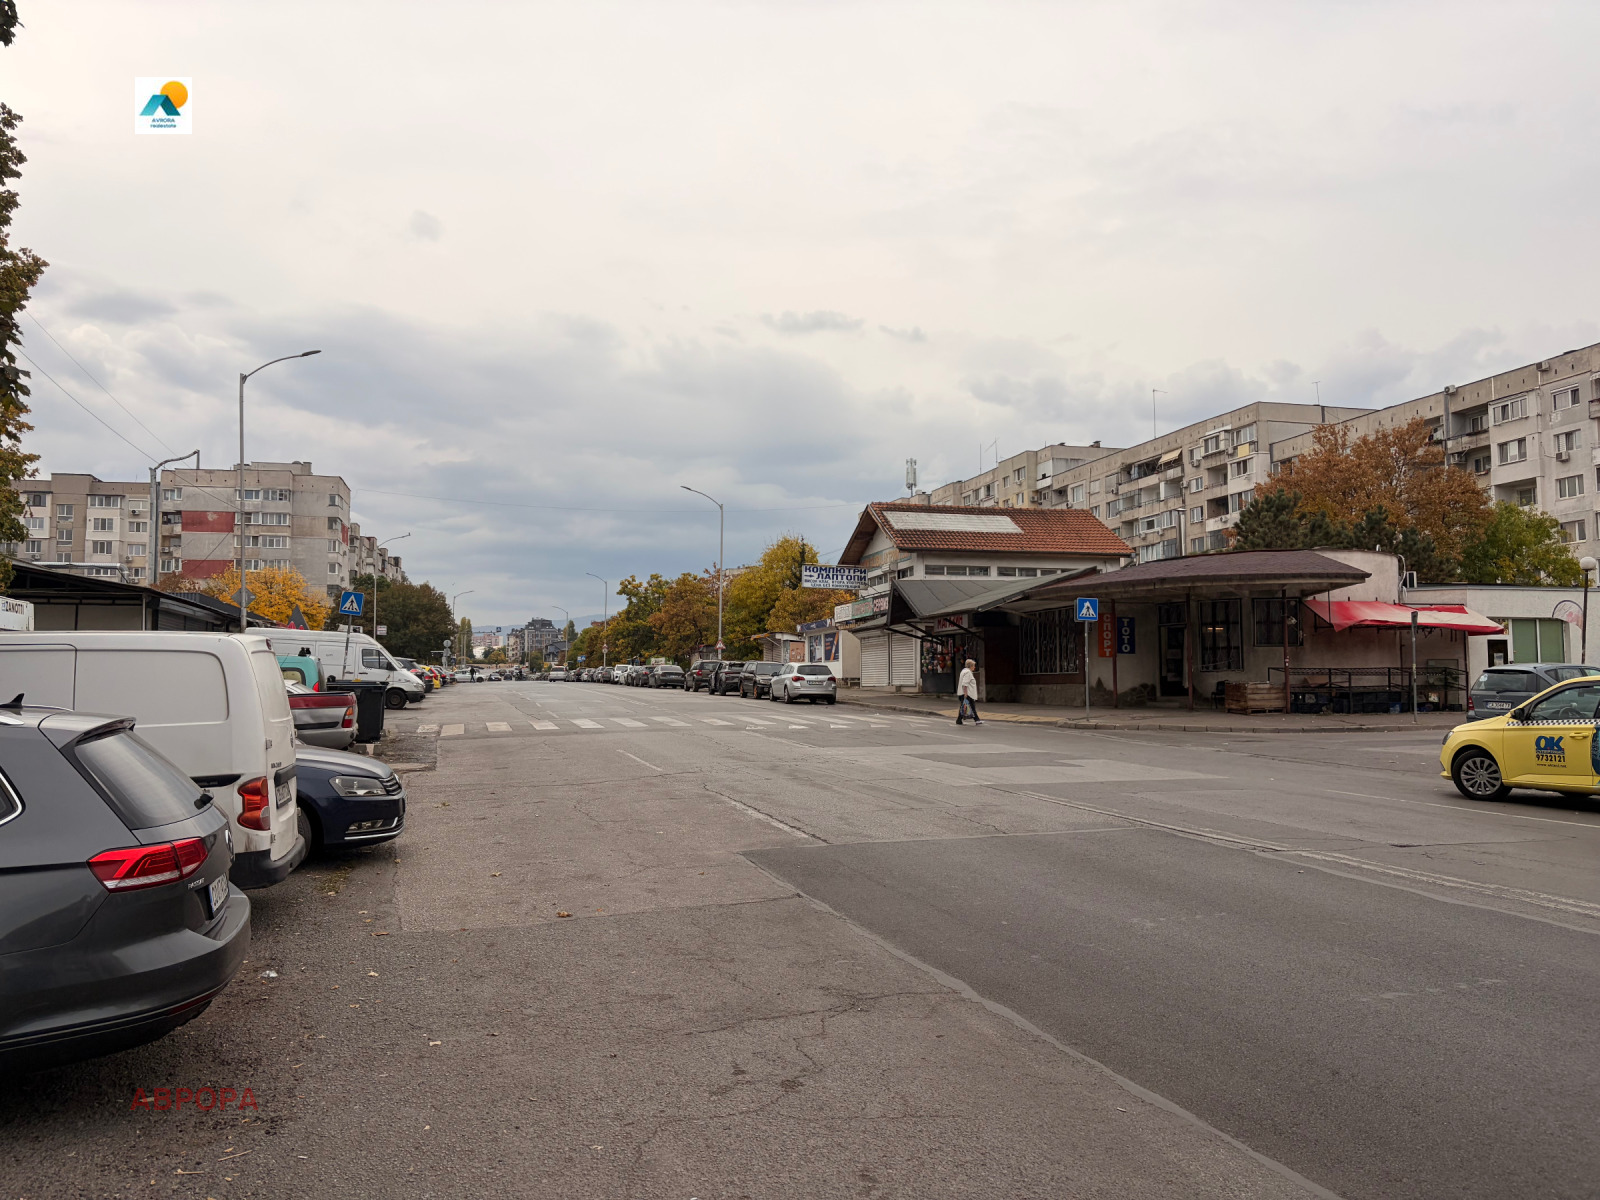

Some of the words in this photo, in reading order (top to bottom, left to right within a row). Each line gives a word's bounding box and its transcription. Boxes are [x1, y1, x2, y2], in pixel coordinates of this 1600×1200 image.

[804, 565, 867, 575] КОМПЮТРИ
[816, 573, 867, 581] ЛАПТОПИ
[5, 600, 25, 615] ZANOTTI
[1103, 613, 1112, 657] СПОРТ
[1121, 618, 1131, 653] ТОТО
[1535, 754, 1566, 763] 9732121
